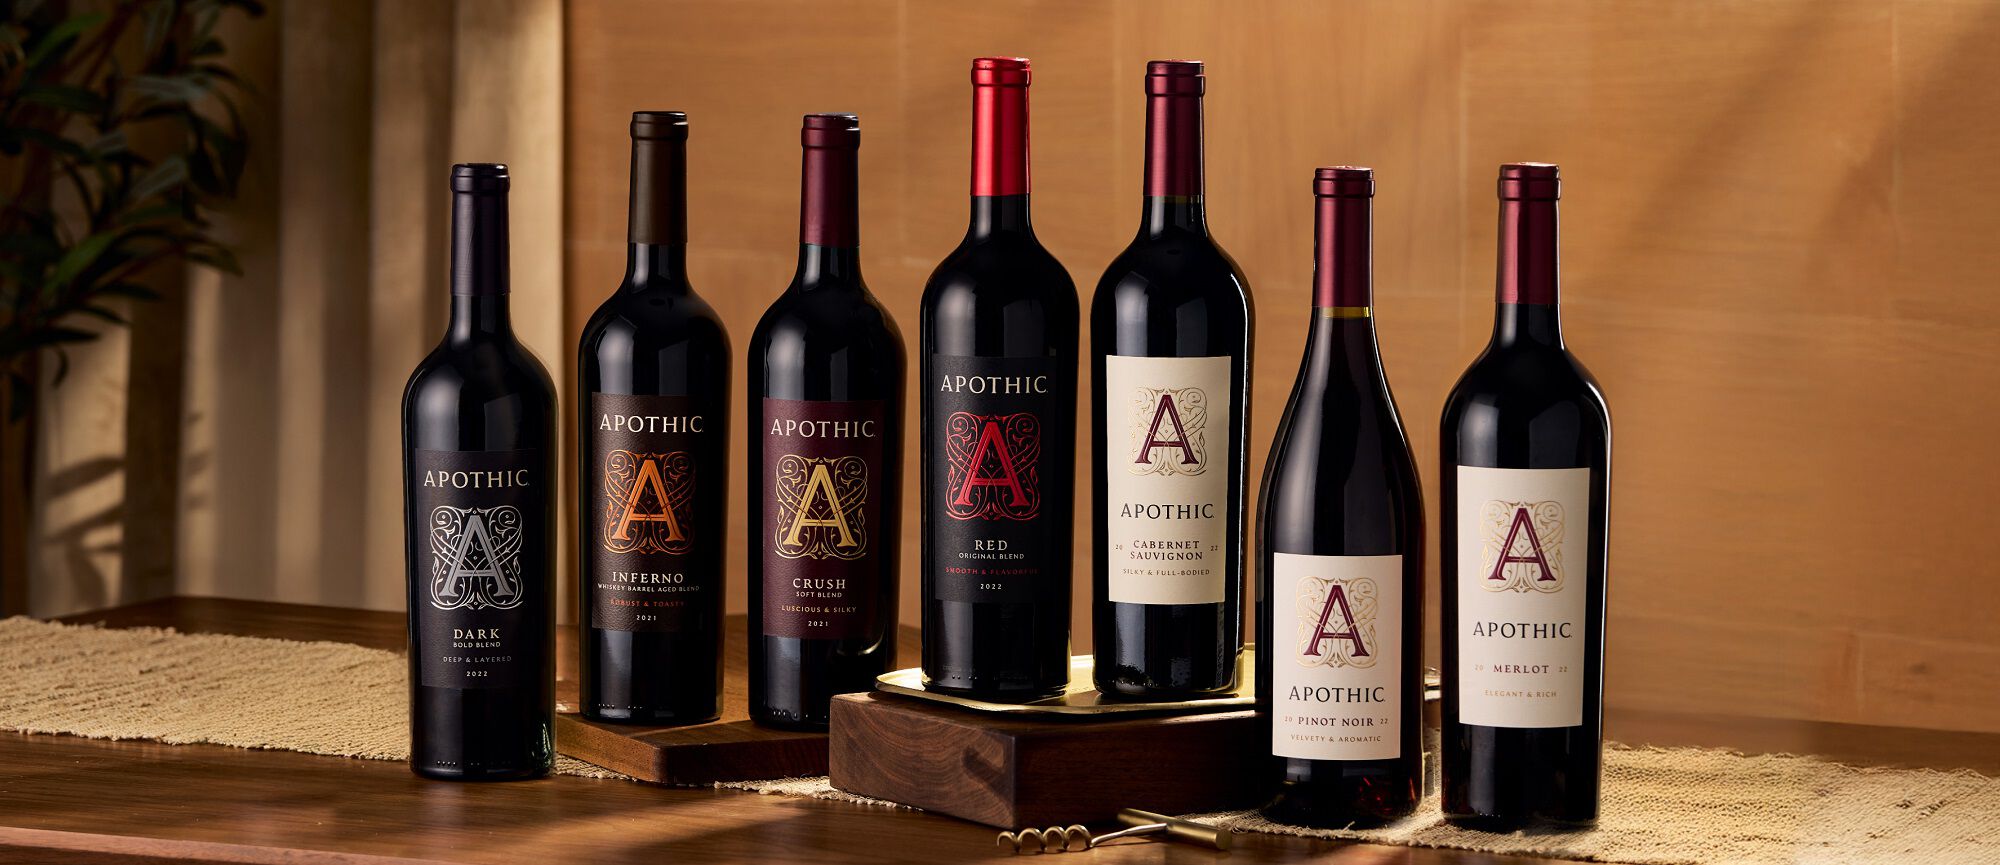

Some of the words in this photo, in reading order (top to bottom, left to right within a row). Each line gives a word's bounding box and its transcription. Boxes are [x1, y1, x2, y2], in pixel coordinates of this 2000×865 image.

[941, 375, 1048, 394] APOTHIC
[600, 414, 703, 433] APOTHIC
[771, 419, 875, 438] APOTHIC
[424, 470, 529, 488] APOTHIC
[1121, 503, 1214, 520] APOTHIC
[975, 540, 1008, 551] RED
[1134, 540, 1200, 549] CABERNET
[1130, 551, 1203, 560] SAUVIGNON
[945, 567, 978, 575] SMOOTH
[612, 572, 683, 583] INFERNO
[598, 583, 625, 591] WHISKEY
[793, 578, 846, 589] CRUSH
[781, 605, 821, 613] LUSCIOUS
[454, 629, 500, 639] DARK
[1473, 622, 1572, 638] APOTHIC
[1493, 665, 1549, 674] MERLOT
[1289, 686, 1386, 702] APOTHIC
[1298, 717, 1336, 726] PINOT
[1342, 718, 1374, 727] NOIR
[1291, 734, 1325, 742] VELVETY
